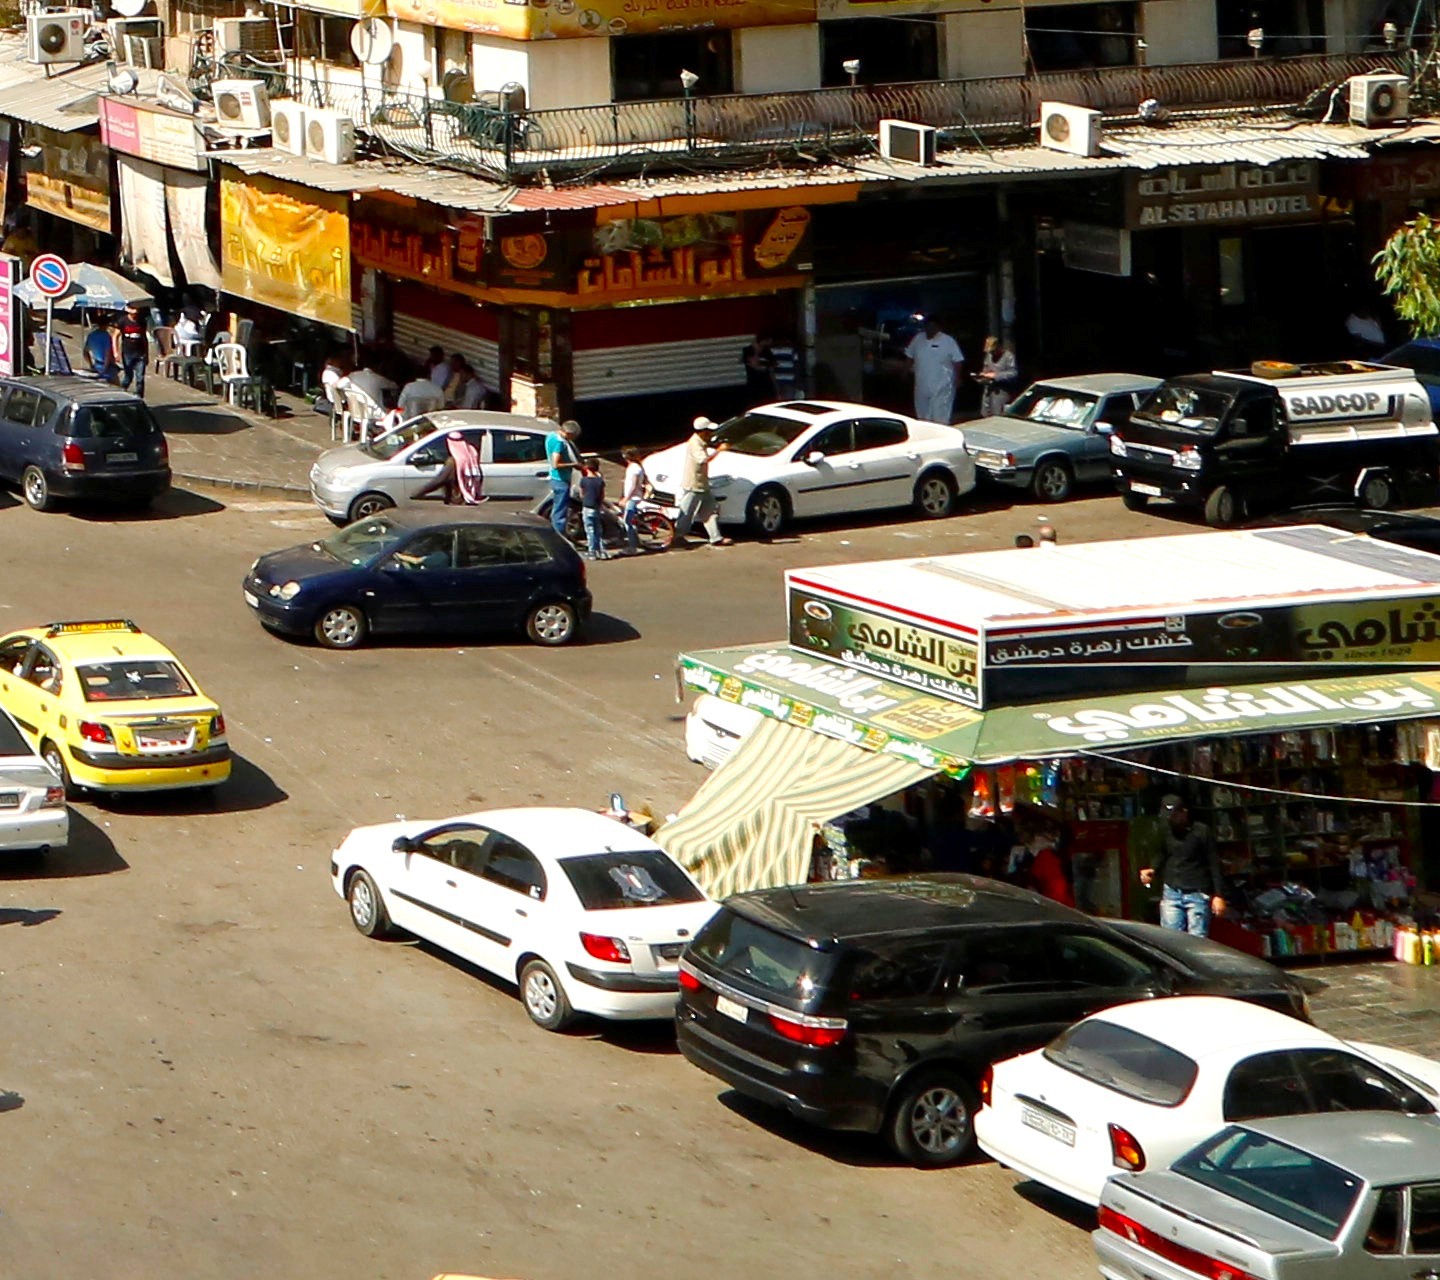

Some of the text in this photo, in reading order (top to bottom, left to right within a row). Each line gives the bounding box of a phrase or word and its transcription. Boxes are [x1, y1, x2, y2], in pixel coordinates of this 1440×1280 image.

[1140, 206, 1167, 225] AL
[1247, 195, 1313, 216] HOTEL
[226, 233, 304, 290] الشامات
[1290, 392, 1381, 416] SADCOP
[847, 622, 977, 684] بن الشامي
[989, 643, 1067, 665] دمشق
[1070, 637, 1121, 659] زهرة
[1126, 634, 1193, 652] كشك
[1297, 600, 1440, 661] شامي
[733, 650, 883, 702] الشامي
[841, 648, 977, 701] كشك زهرة دمشق
[1048, 685, 1435, 741] بن الشامي
